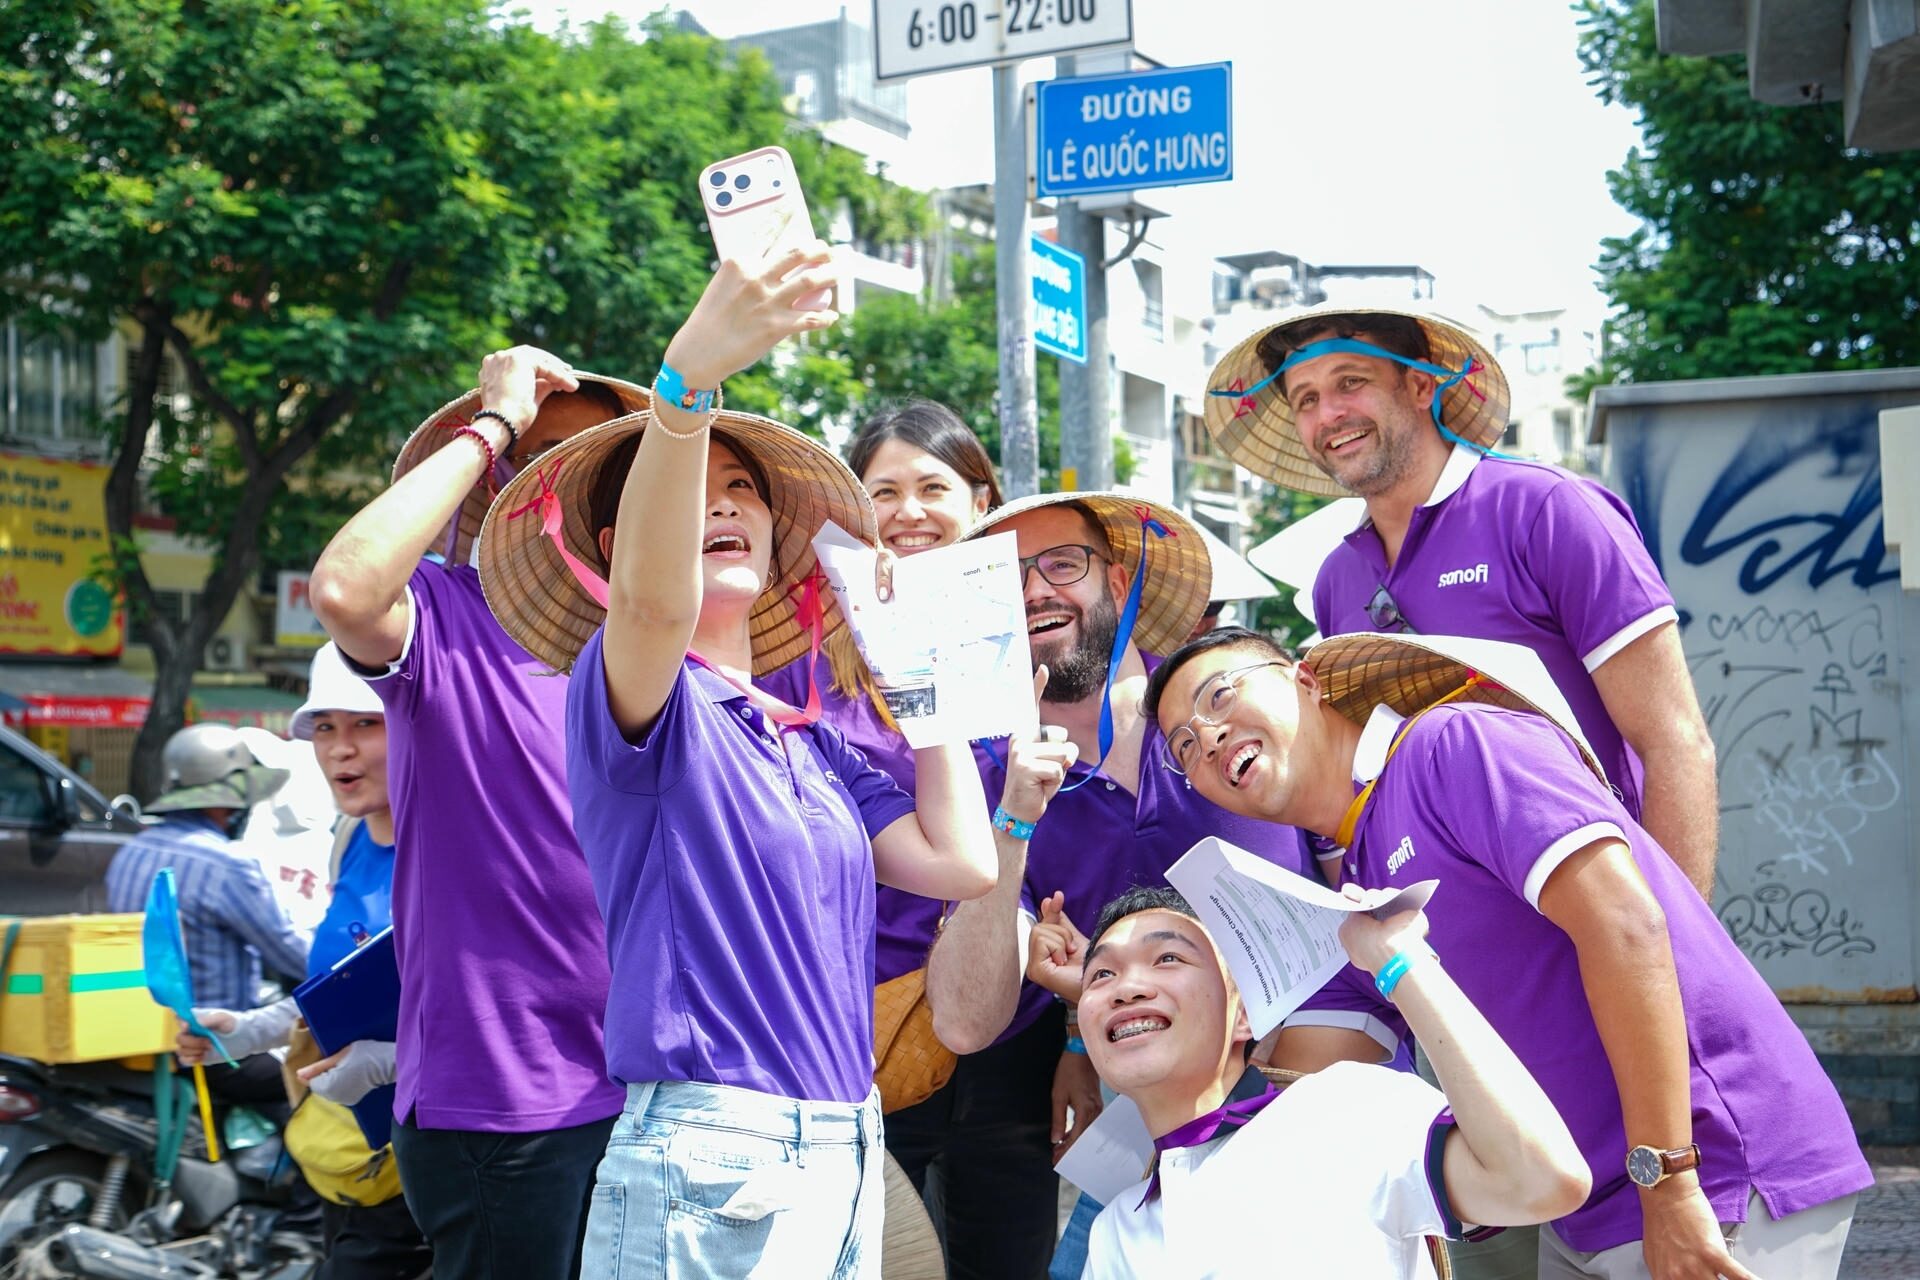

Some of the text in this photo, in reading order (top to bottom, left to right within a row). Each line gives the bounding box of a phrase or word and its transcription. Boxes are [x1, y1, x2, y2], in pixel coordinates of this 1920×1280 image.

[1080, 85, 1192, 123] ĐƯỜNG
[1047, 128, 1226, 183] LÊ QUỐC HƯNG
[1438, 563, 1489, 588] sanofi
[1209, 894, 1236, 930] Challenge
[1234, 929, 1257, 965] Language
[1254, 963, 1273, 1007] Vietnamese
